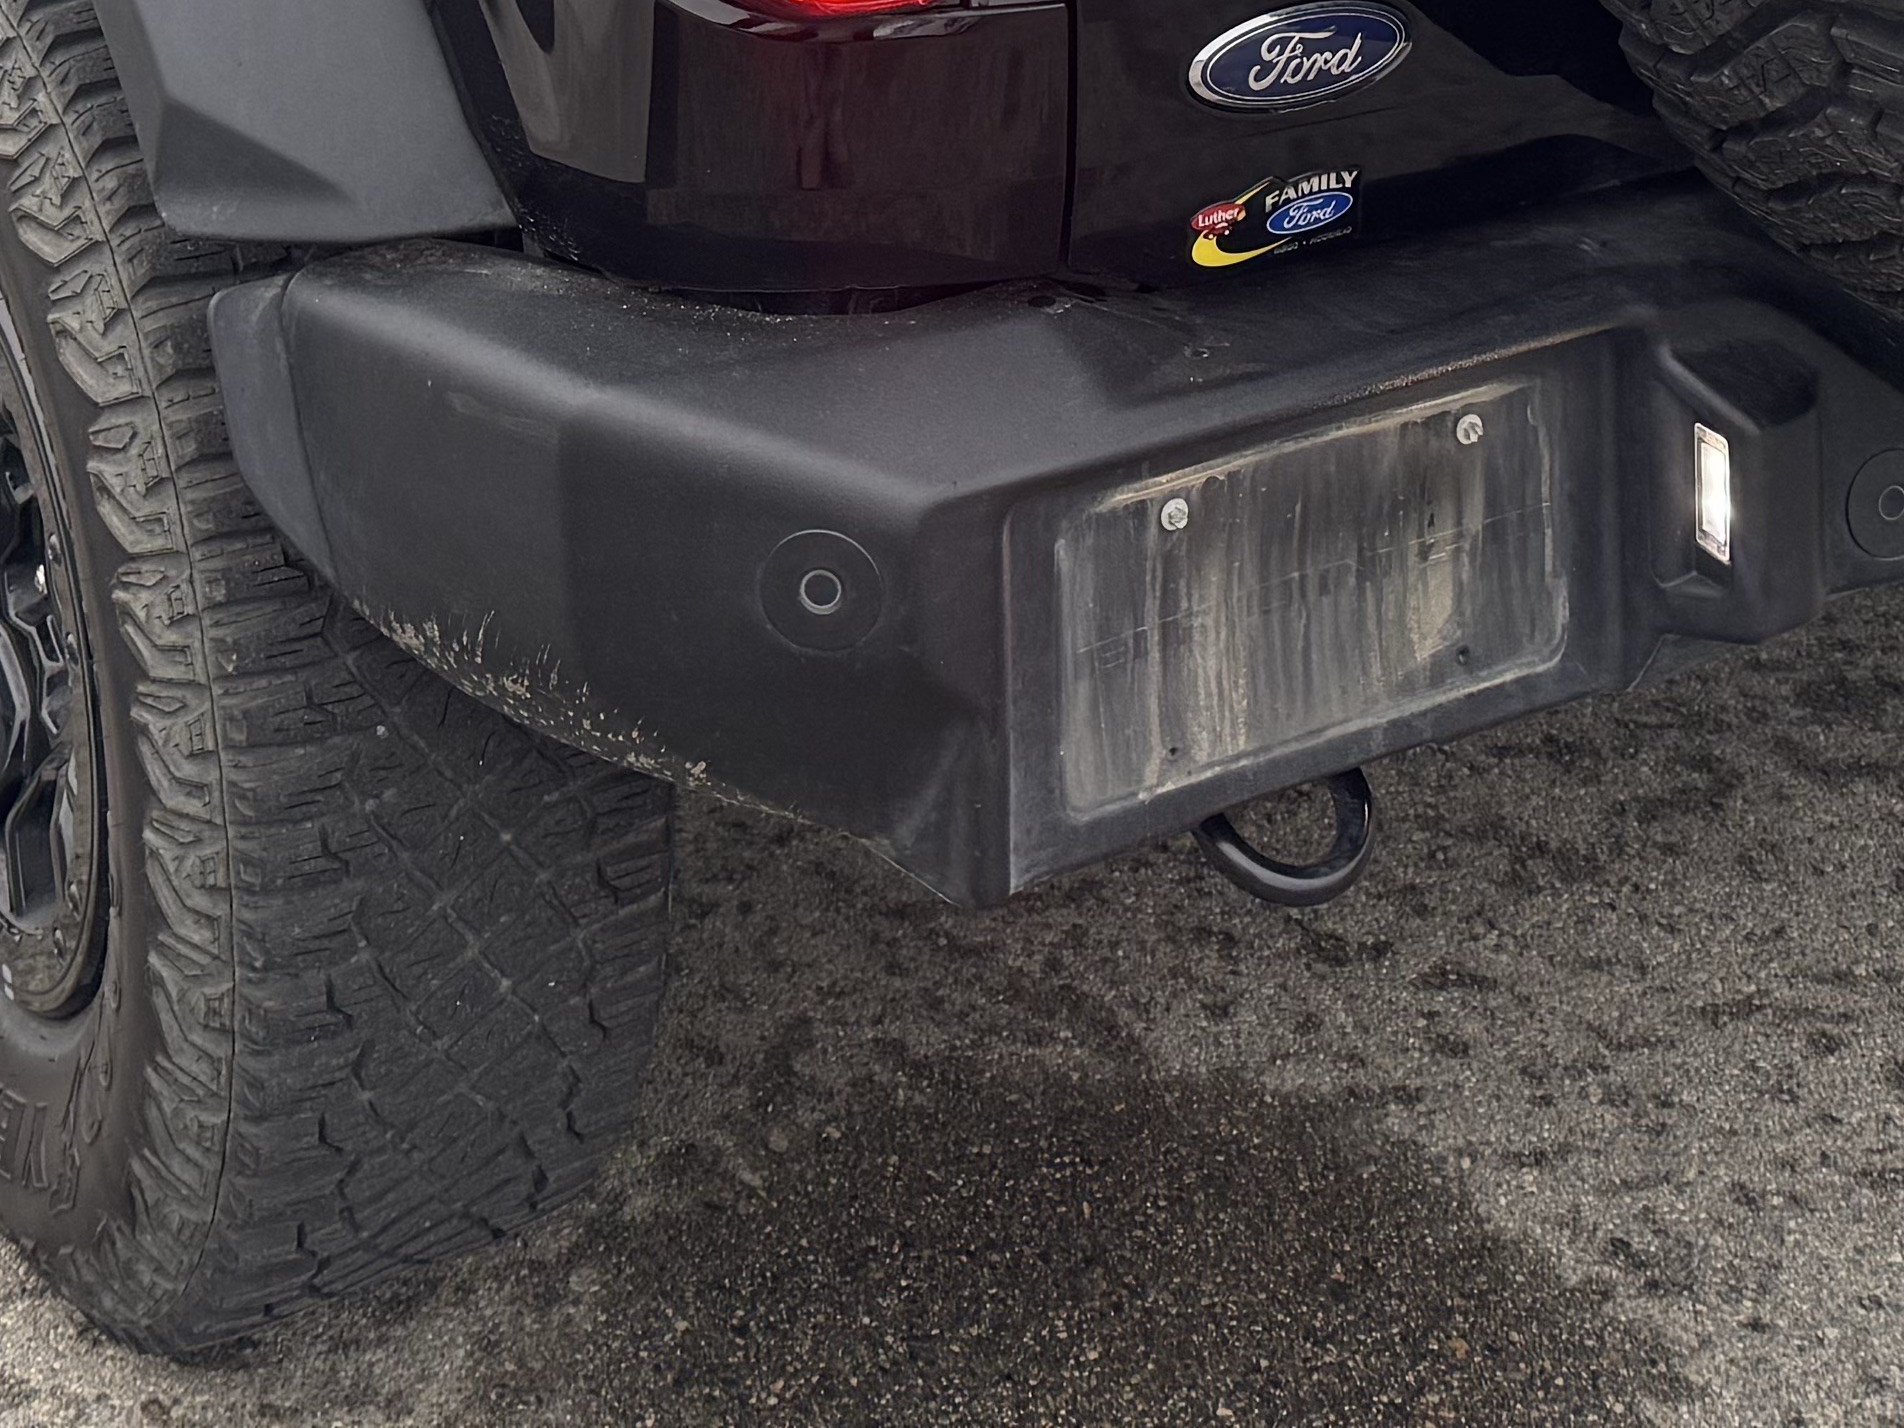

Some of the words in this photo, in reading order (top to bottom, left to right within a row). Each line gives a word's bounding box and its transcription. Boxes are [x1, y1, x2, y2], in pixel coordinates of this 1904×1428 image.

[1248, 25, 1362, 90] Ford
[1265, 170, 1358, 212] FAMILY
[1198, 208, 1239, 227] Luther
[1284, 200, 1336, 228] Ford
